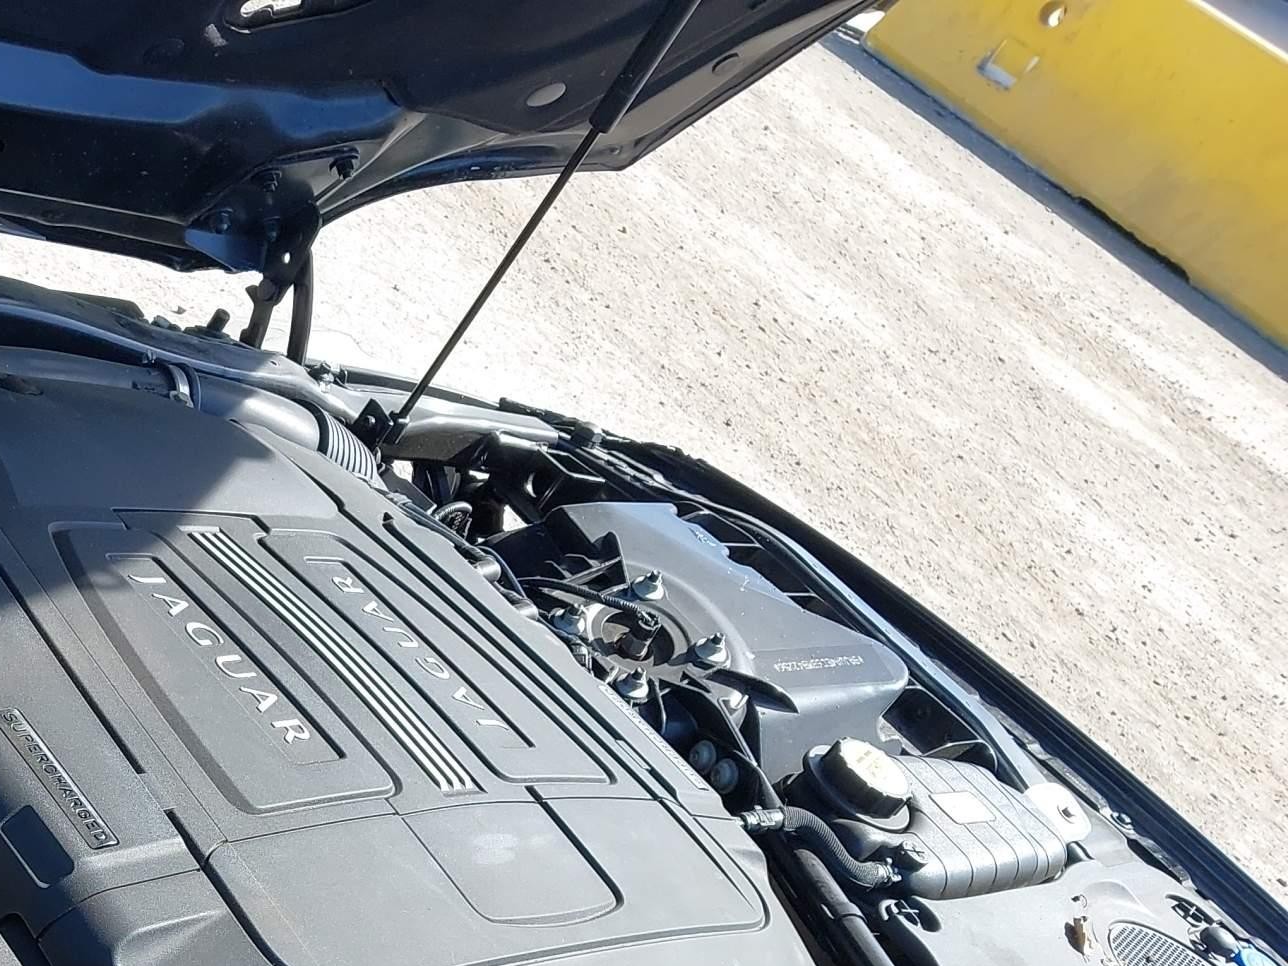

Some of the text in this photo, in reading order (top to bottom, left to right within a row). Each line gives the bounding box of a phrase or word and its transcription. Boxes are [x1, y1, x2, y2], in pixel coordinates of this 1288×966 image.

[128, 572, 312, 746] JAGUAR
[329, 574, 510, 731] JAGUAR
[1, 711, 108, 842] SUPERCHARGED
